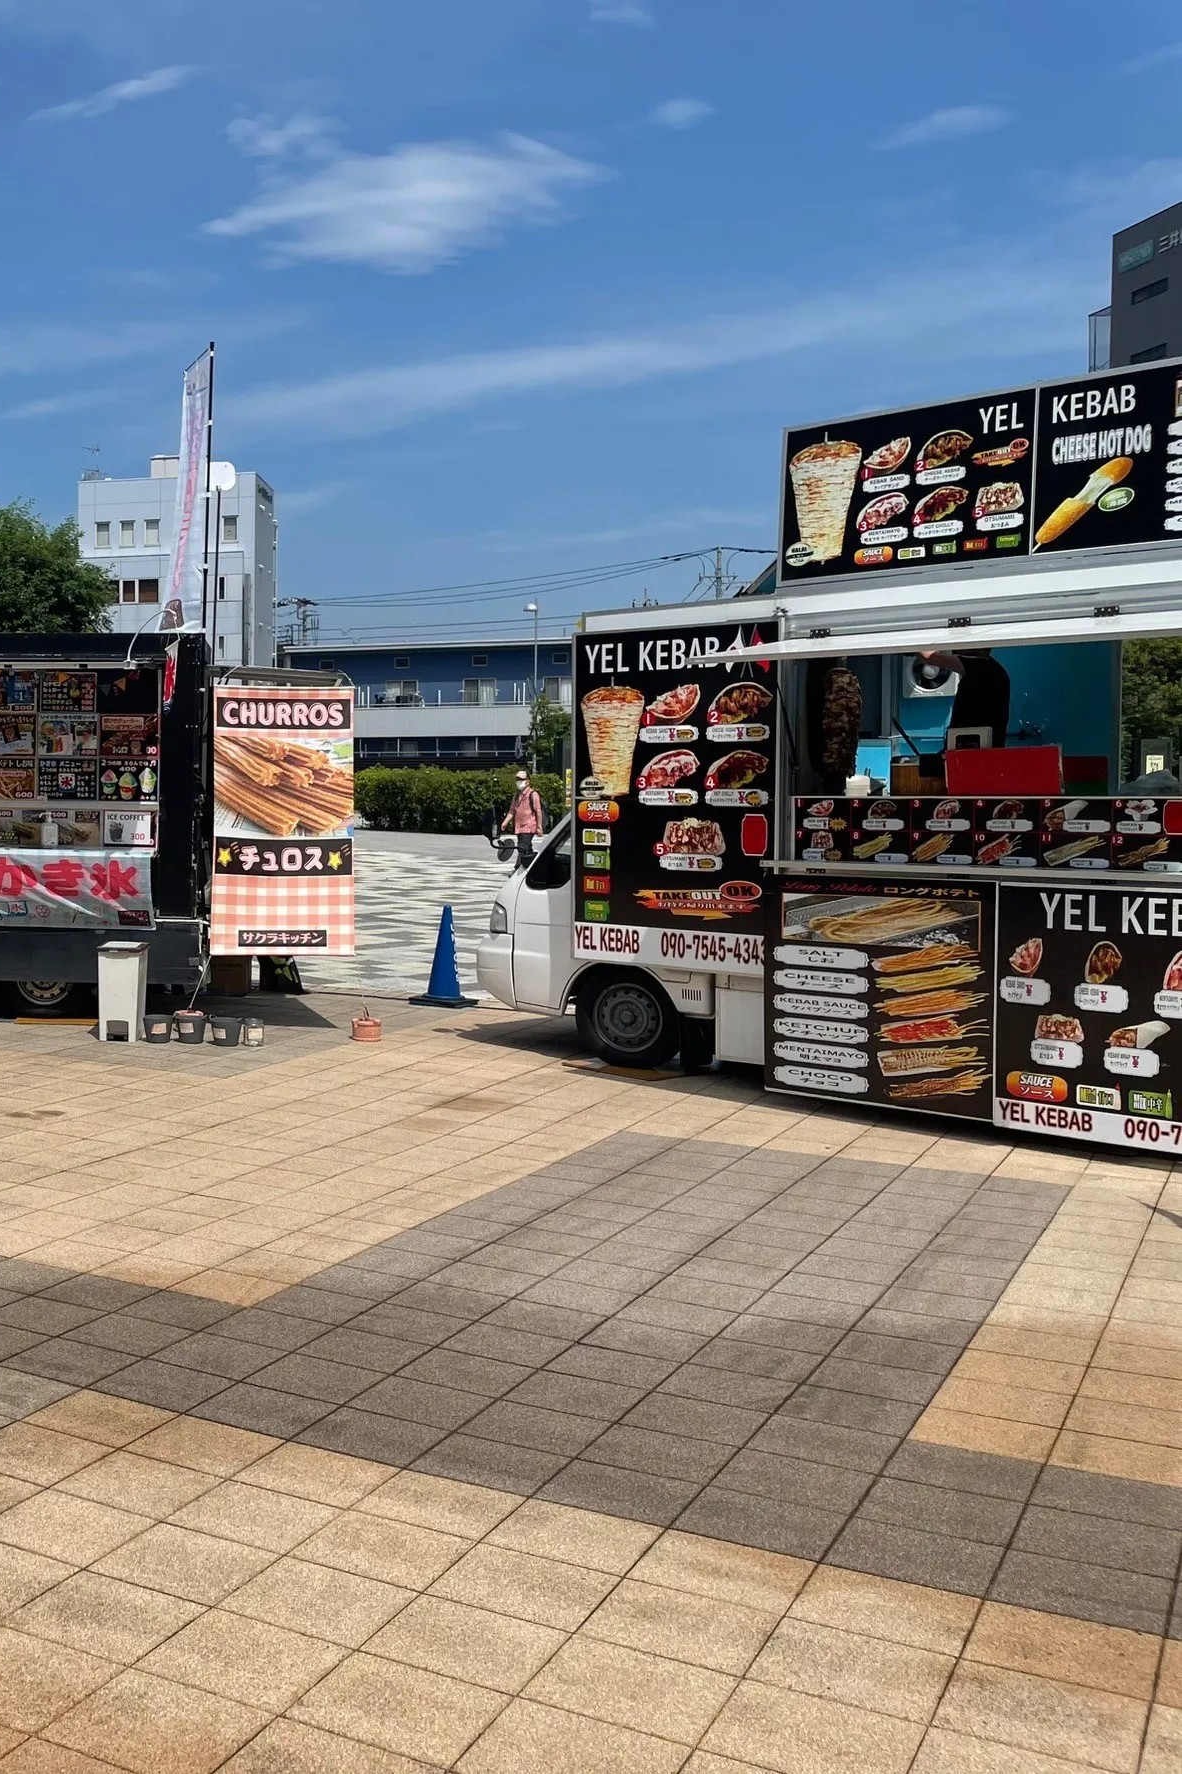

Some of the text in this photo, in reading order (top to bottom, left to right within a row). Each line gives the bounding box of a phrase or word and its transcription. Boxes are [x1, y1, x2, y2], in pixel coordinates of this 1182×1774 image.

[1158, 229, 1182, 254] 三井
[979, 384, 1136, 434] YEL KEBAB
[1052, 423, 1152, 465] CHEESE HOT DOG
[923, 467, 961, 477] CHEESE KEBAB
[869, 475, 905, 485] KEBAB SAND
[863, 548, 884, 557] SAUCE
[585, 637, 720, 674] YEL KEBAB
[222, 700, 344, 727] CHURROS
[710, 711, 718, 723] 2
[638, 777, 647, 788] 3
[707, 777, 716, 788] 4
[587, 803, 610, 812] SAUCE
[107, 814, 146, 822] ICE COFFEE
[587, 812, 611, 820] ソース
[129, 833, 146, 841] 300
[975, 834, 985, 842] 10
[1042, 834, 1051, 842] 11
[1112, 836, 1124, 845] 12
[656, 843, 664, 855] 5
[238, 845, 324, 872] チュロス
[726, 886, 755, 897] OK
[883, 886, 980, 898] ロングポテト
[1039, 892, 1107, 933] YEL
[242, 932, 324, 944] サクラキッチン
[575, 925, 597, 950] YEL
[600, 928, 640, 954] KEBAB
[798, 949, 844, 958] SALT
[808, 956, 835, 964] しお
[784, 972, 855, 984] CHEESE
[796, 981, 844, 990] チーズ
[779, 996, 867, 1010] KEBAB SAUCE
[790, 1004, 853, 1017] ケバブソース
[779, 1020, 866, 1034] KETCHUP
[785, 1028, 857, 1041] ケチャップ
[778, 1044, 865, 1060] MENTAIMAYO
[799, 1054, 842, 1064] 明太マヨ
[788, 1069, 853, 1082] CHOCO
[1020, 1074, 1054, 1089] SAUCE
[800, 1077, 839, 1087] チョコ
[1019, 1087, 1054, 1100] ソース
[999, 1100, 1030, 1124] YEL
[1035, 1105, 1093, 1132] KEBAB
